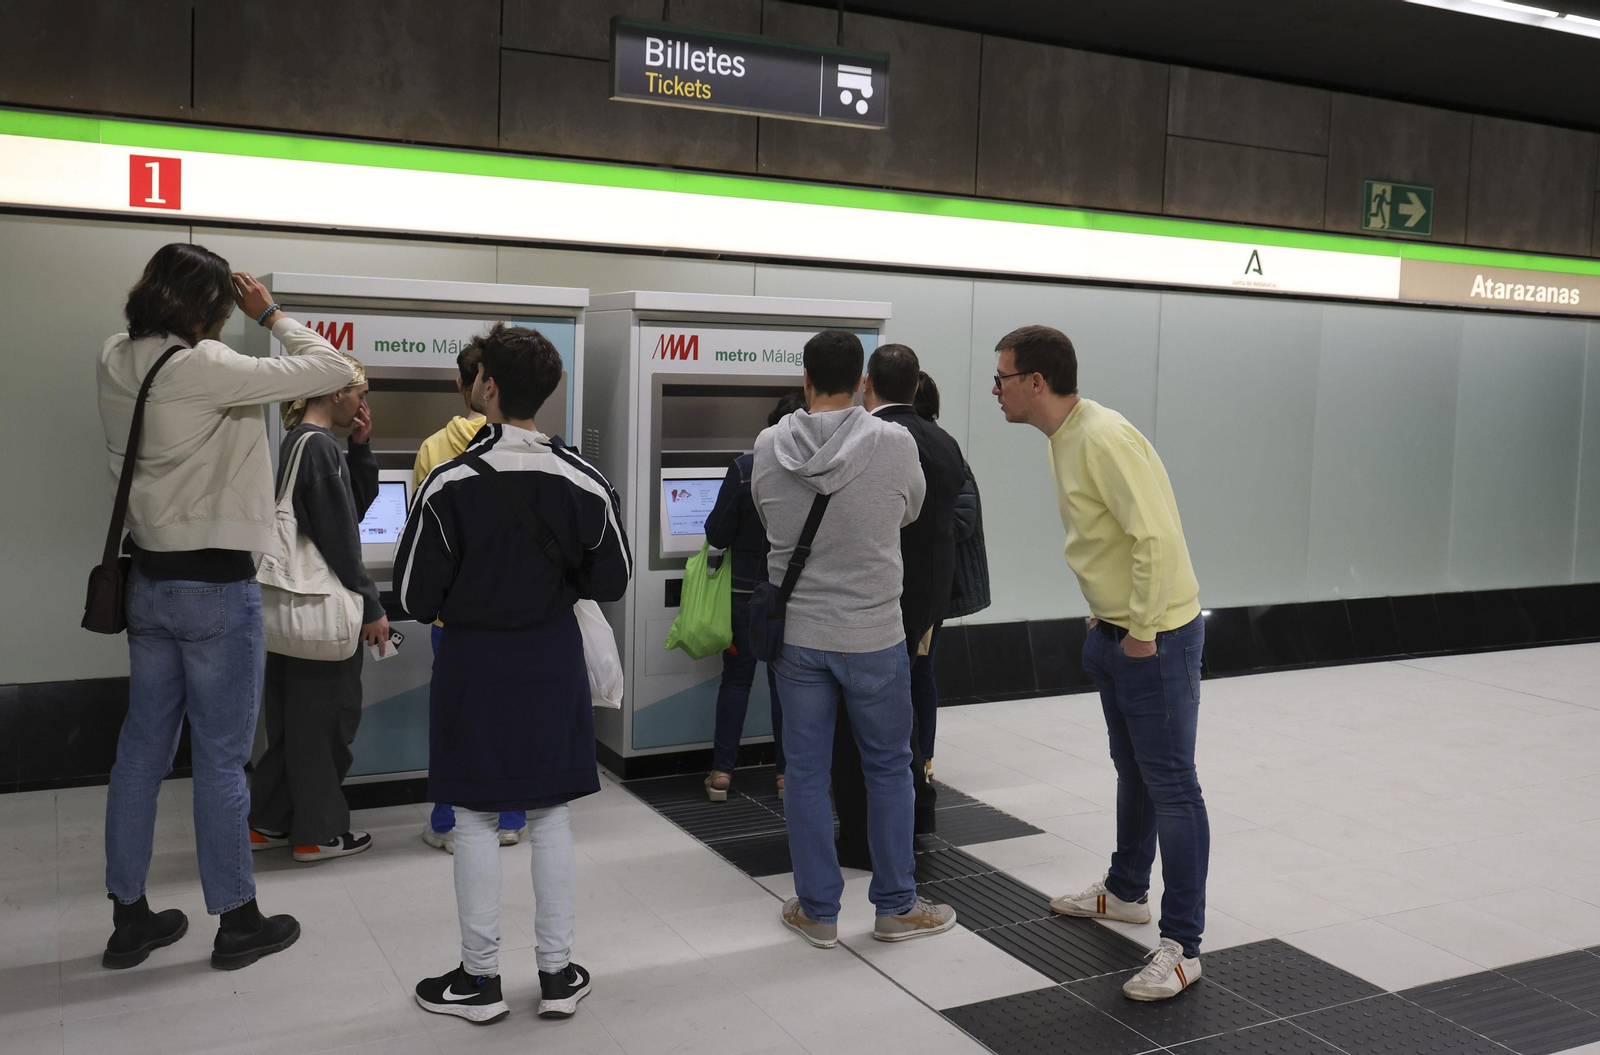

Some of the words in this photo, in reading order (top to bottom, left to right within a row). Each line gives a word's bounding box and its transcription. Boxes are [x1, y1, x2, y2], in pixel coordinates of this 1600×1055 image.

[645, 37, 746, 77] Billetes
[645, 72, 712, 99] Tickets
[144, 161, 167, 204] 1
[1470, 274, 1580, 305] Atarazanas
[374, 338, 426, 353] metro
[432, 338, 472, 354] Mál
[715, 348, 757, 362] metro
[762, 349, 803, 366] Málag
